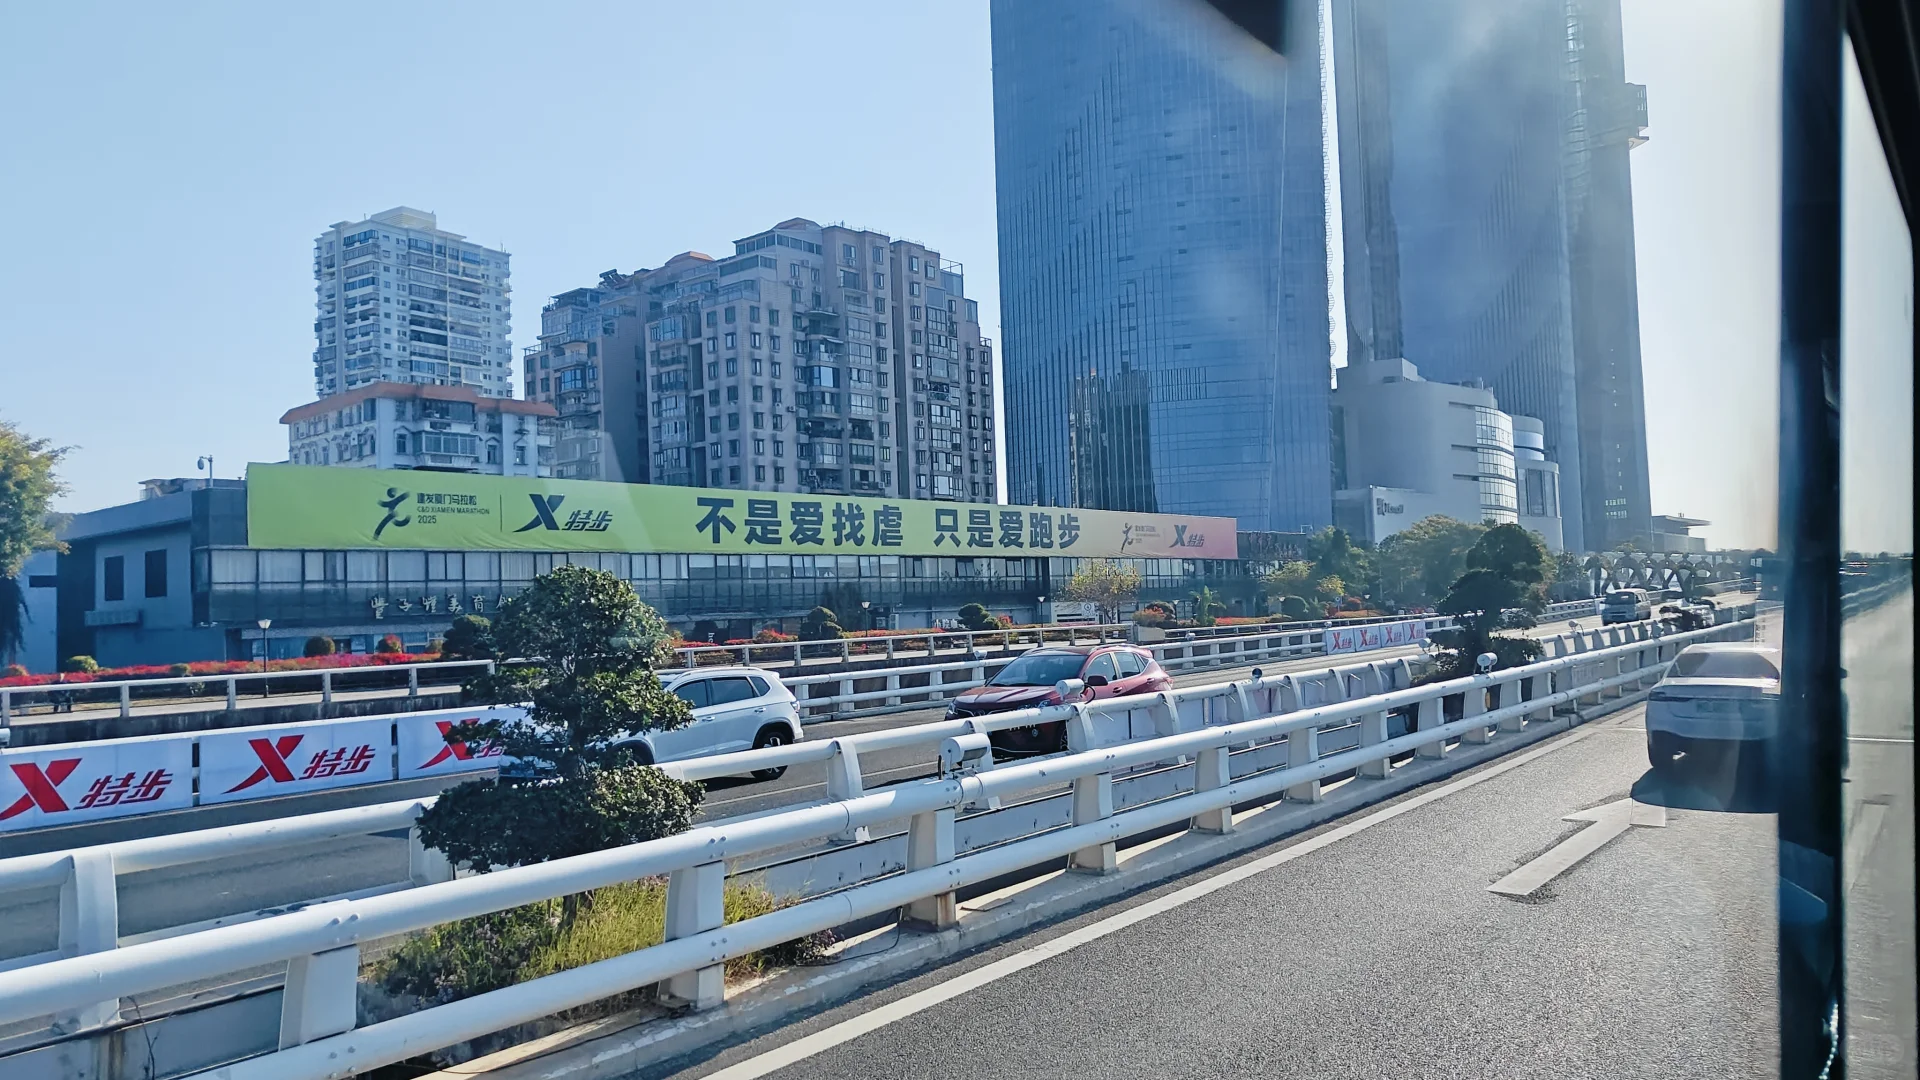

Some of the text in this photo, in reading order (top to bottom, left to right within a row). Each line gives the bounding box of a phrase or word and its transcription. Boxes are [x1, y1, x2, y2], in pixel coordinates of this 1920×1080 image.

[417, 515, 437, 524] 2025
[456, 507, 490, 515] MARATHON
[561, 509, 613, 532] 特步
[695, 496, 1081, 549] 不是爱找虐 只是爱跑步
[298, 744, 377, 781] 特步
[73, 768, 174, 811] 特步
